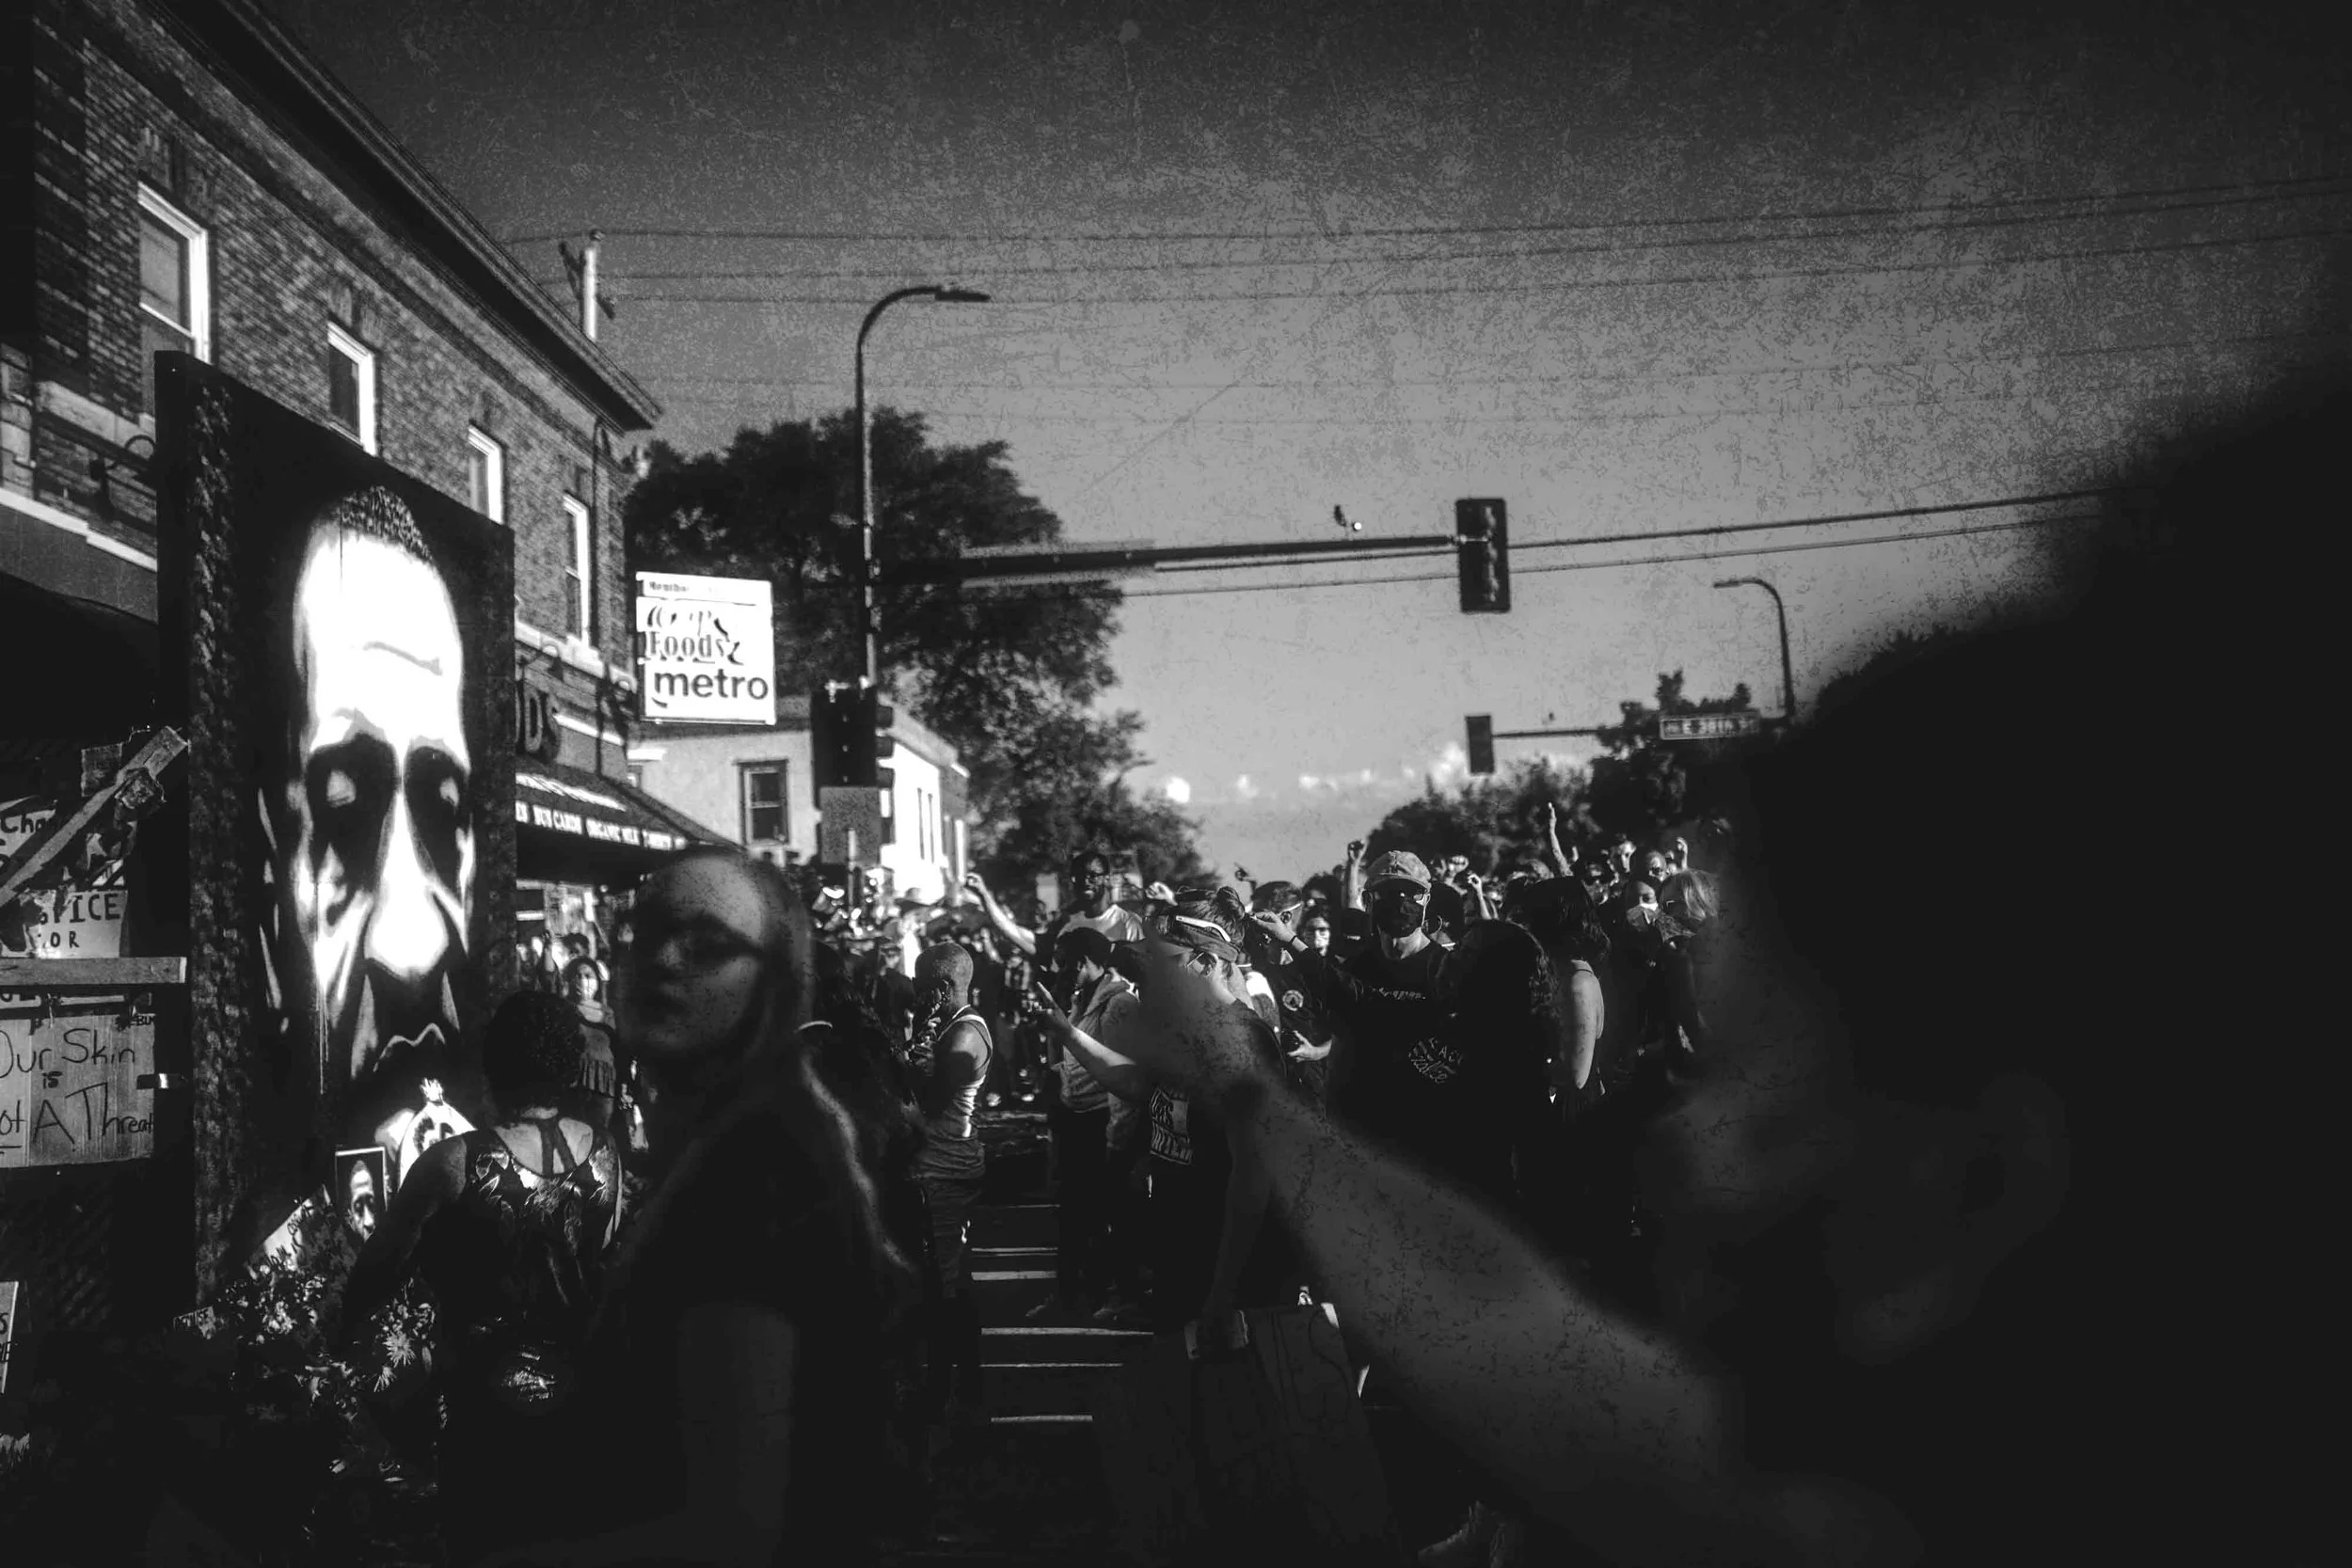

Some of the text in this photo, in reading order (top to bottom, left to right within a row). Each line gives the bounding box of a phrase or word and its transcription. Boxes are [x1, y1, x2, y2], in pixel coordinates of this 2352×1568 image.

[653, 669, 769, 700] metro
[62, 1028, 136, 1066] Skin
[0, 1082, 154, 1145] ot A Threat
